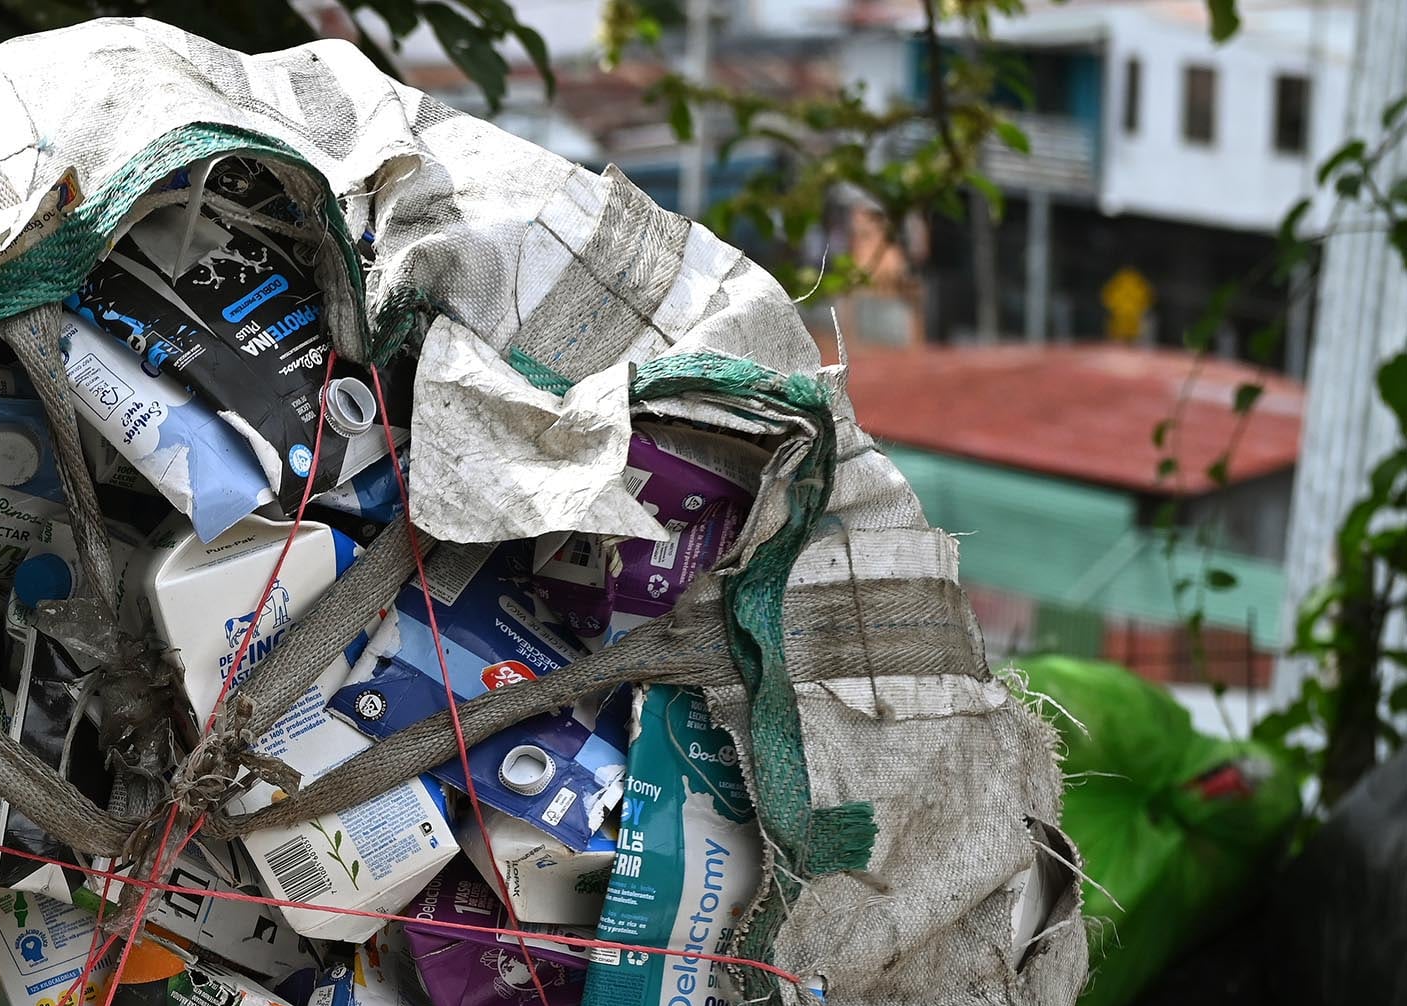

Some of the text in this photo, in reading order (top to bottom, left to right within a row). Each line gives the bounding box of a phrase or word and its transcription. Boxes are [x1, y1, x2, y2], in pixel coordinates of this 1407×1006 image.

[233, 320, 261, 341] Plus
[278, 351, 316, 376] Pinos
[505, 600, 524, 619] VACA
[528, 620, 541, 633] DE
[234, 630, 286, 666] FINC
[515, 646, 549, 671] LECHE
[219, 656, 233, 667] DE
[222, 671, 252, 692] HAST
[308, 692, 322, 704] fincas
[274, 698, 326, 729] aportando bienestar
[269, 729, 285, 741] 1400
[286, 711, 321, 733] productores
[289, 718, 327, 740] comunidades
[688, 742, 719, 762] Dos
[632, 831, 644, 852] DE
